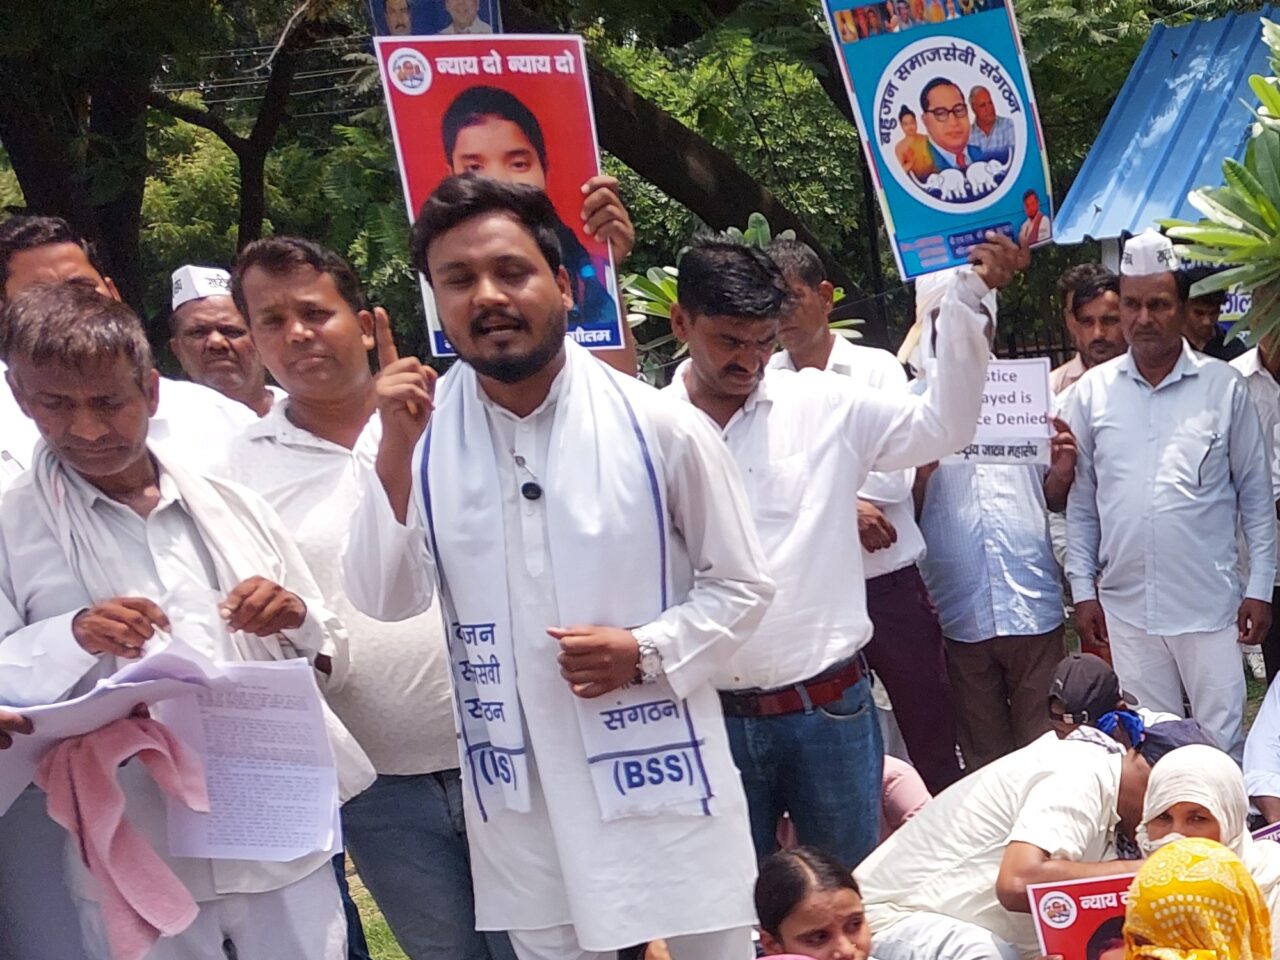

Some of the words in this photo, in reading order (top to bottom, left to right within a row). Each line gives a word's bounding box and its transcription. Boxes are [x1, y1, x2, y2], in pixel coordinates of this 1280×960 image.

[435, 56, 479, 75] न्याय
[480, 49, 502, 74] दो
[507, 55, 551, 74] न्याय
[554, 49, 576, 74] दो
[879, 79, 899, 146] बहुजन
[893, 42, 977, 81] समाजसेवी
[1021, 391, 1032, 404] is
[996, 412, 1049, 425] Denied
[600, 700, 680, 730] संगठन
[613, 751, 694, 795] (BSS)
[1079, 892, 1118, 909] न्याय
